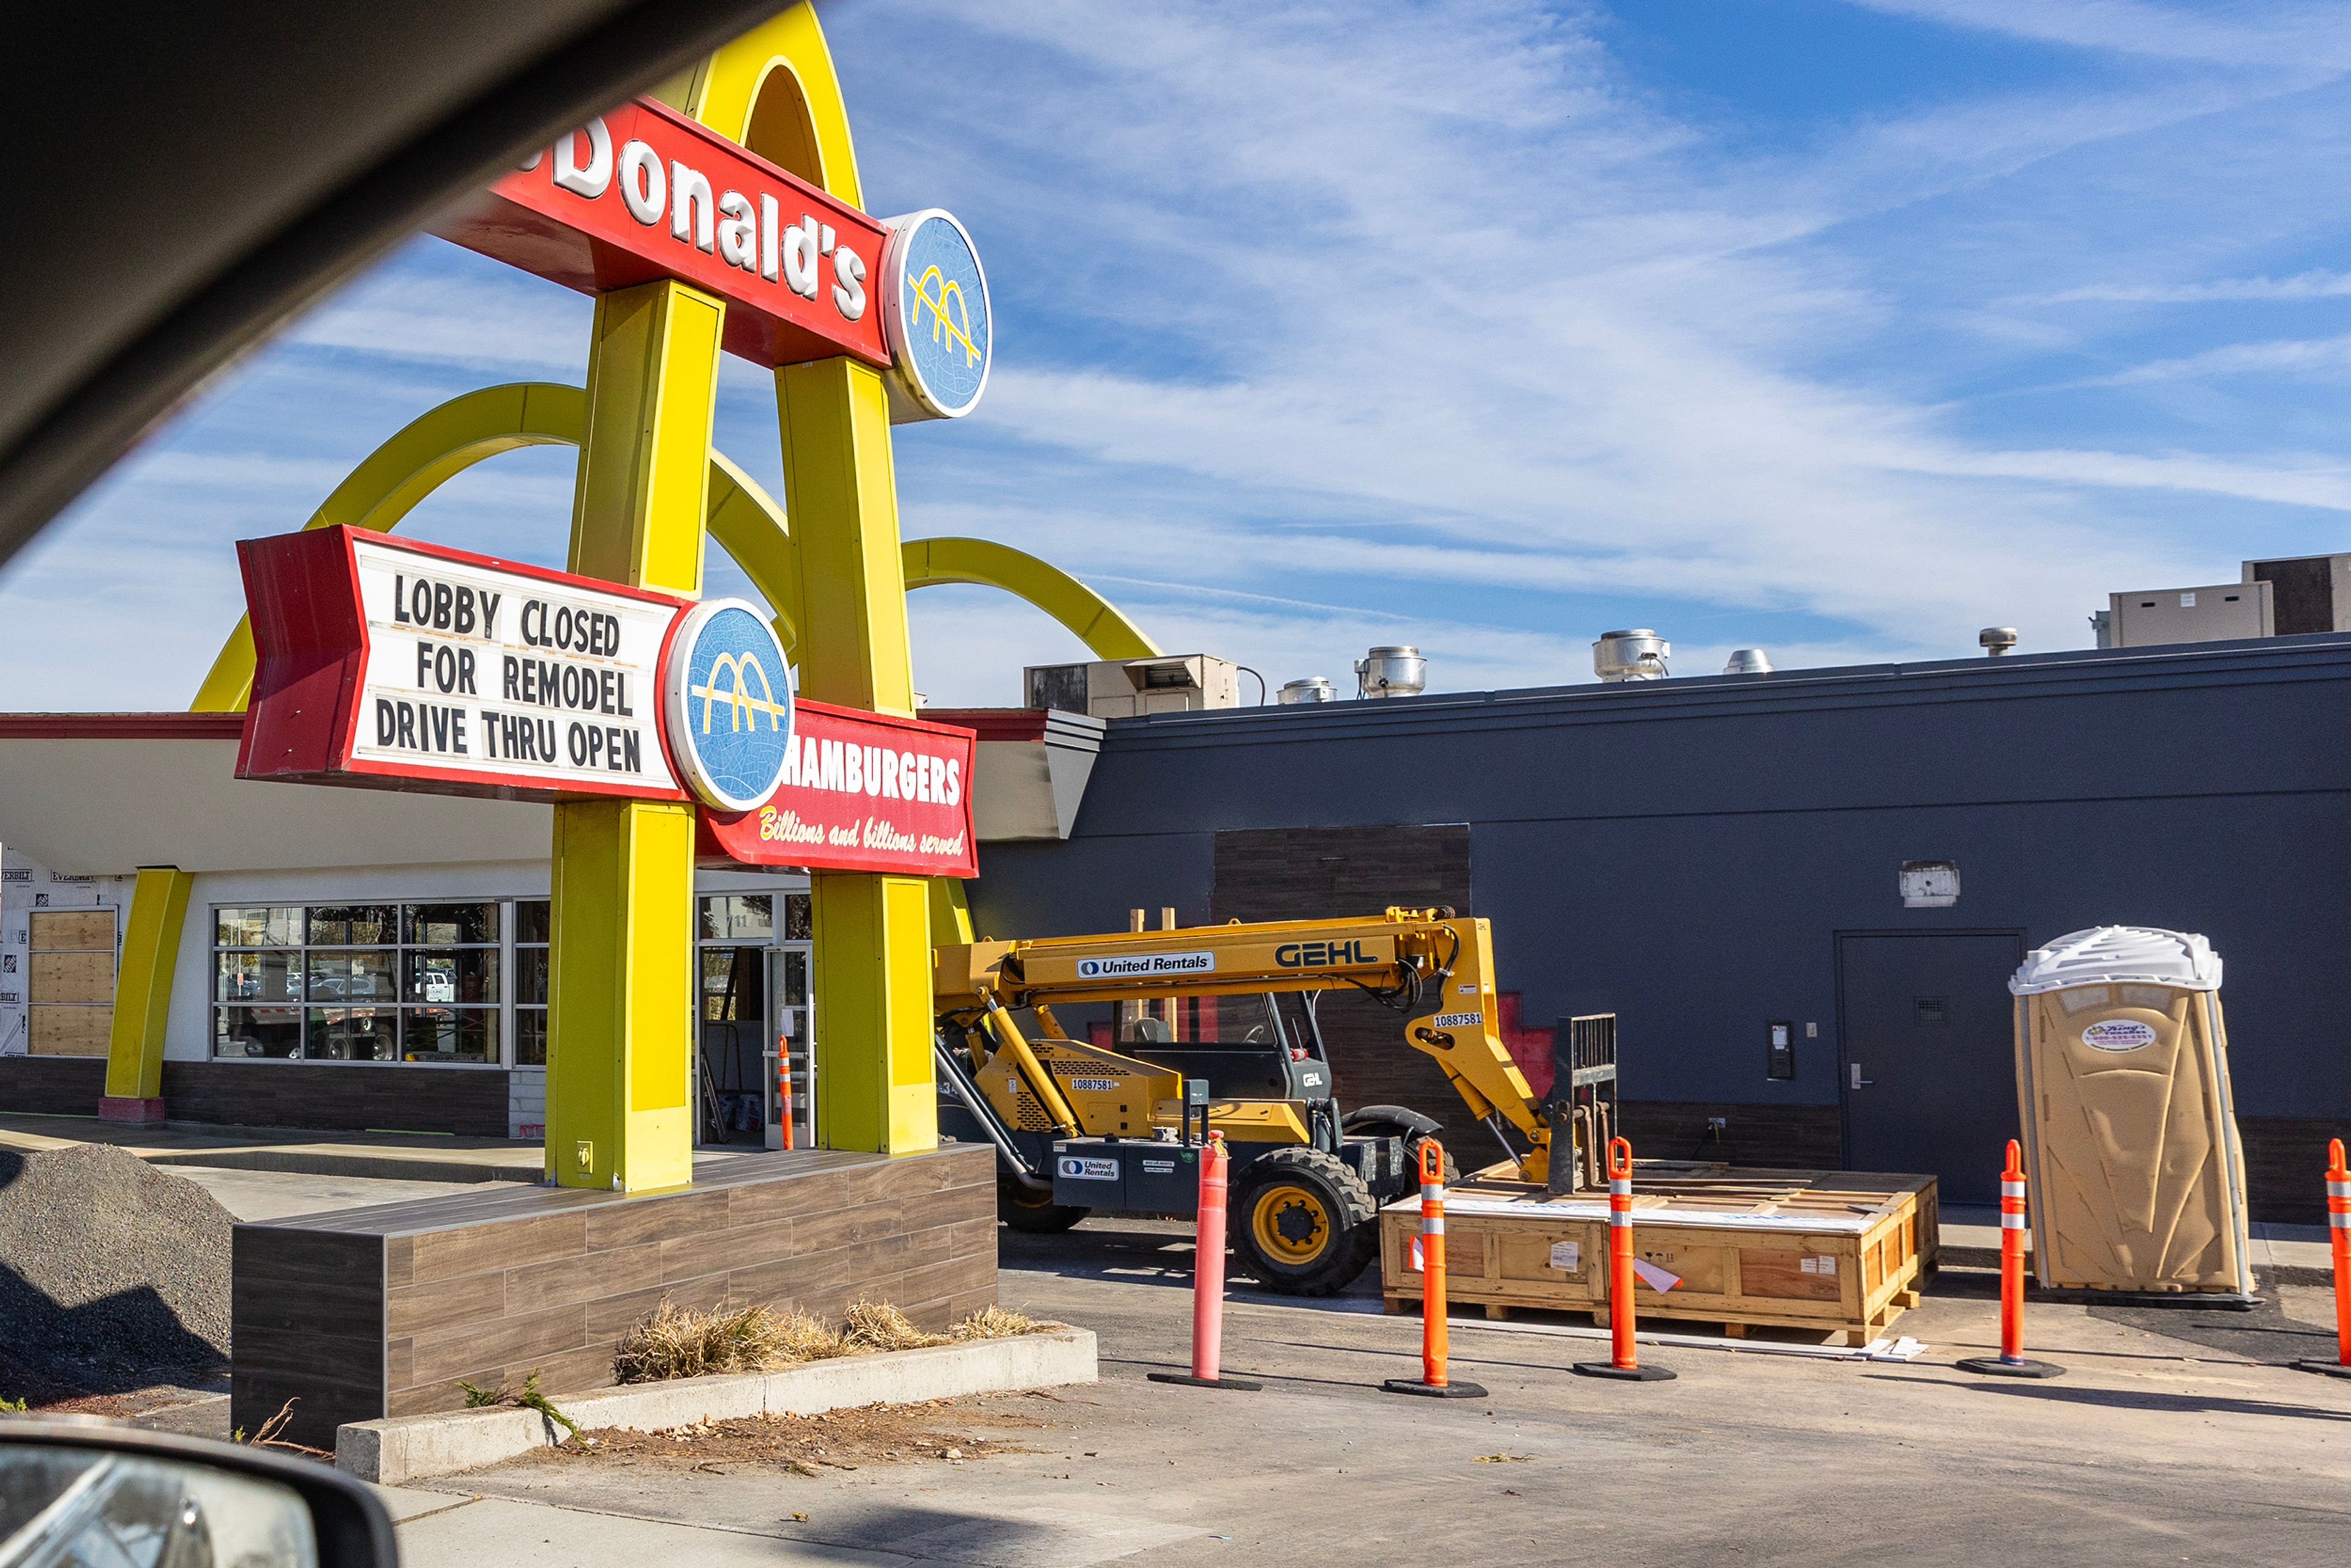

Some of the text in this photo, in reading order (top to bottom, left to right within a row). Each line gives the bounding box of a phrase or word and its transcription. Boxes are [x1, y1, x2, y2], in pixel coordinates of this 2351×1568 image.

[517, 115, 867, 321] Donald's
[396, 575, 620, 658] LOBBY CLOSED
[418, 641, 633, 717] FOR REMODEL
[377, 699, 641, 773] DRIVE THRU OPEN
[781, 734, 961, 806] HAMBURGERS
[759, 805, 963, 857] Billions and billions served
[1103, 955, 1208, 973] United Rentals
[1275, 940, 1378, 967] GEHL
[1435, 1013, 1482, 1027] 10887581
[1073, 1079, 1112, 1090] 10887581
[1084, 1161, 1112, 1169] United
[1084, 1168, 1115, 1177] Rentals
